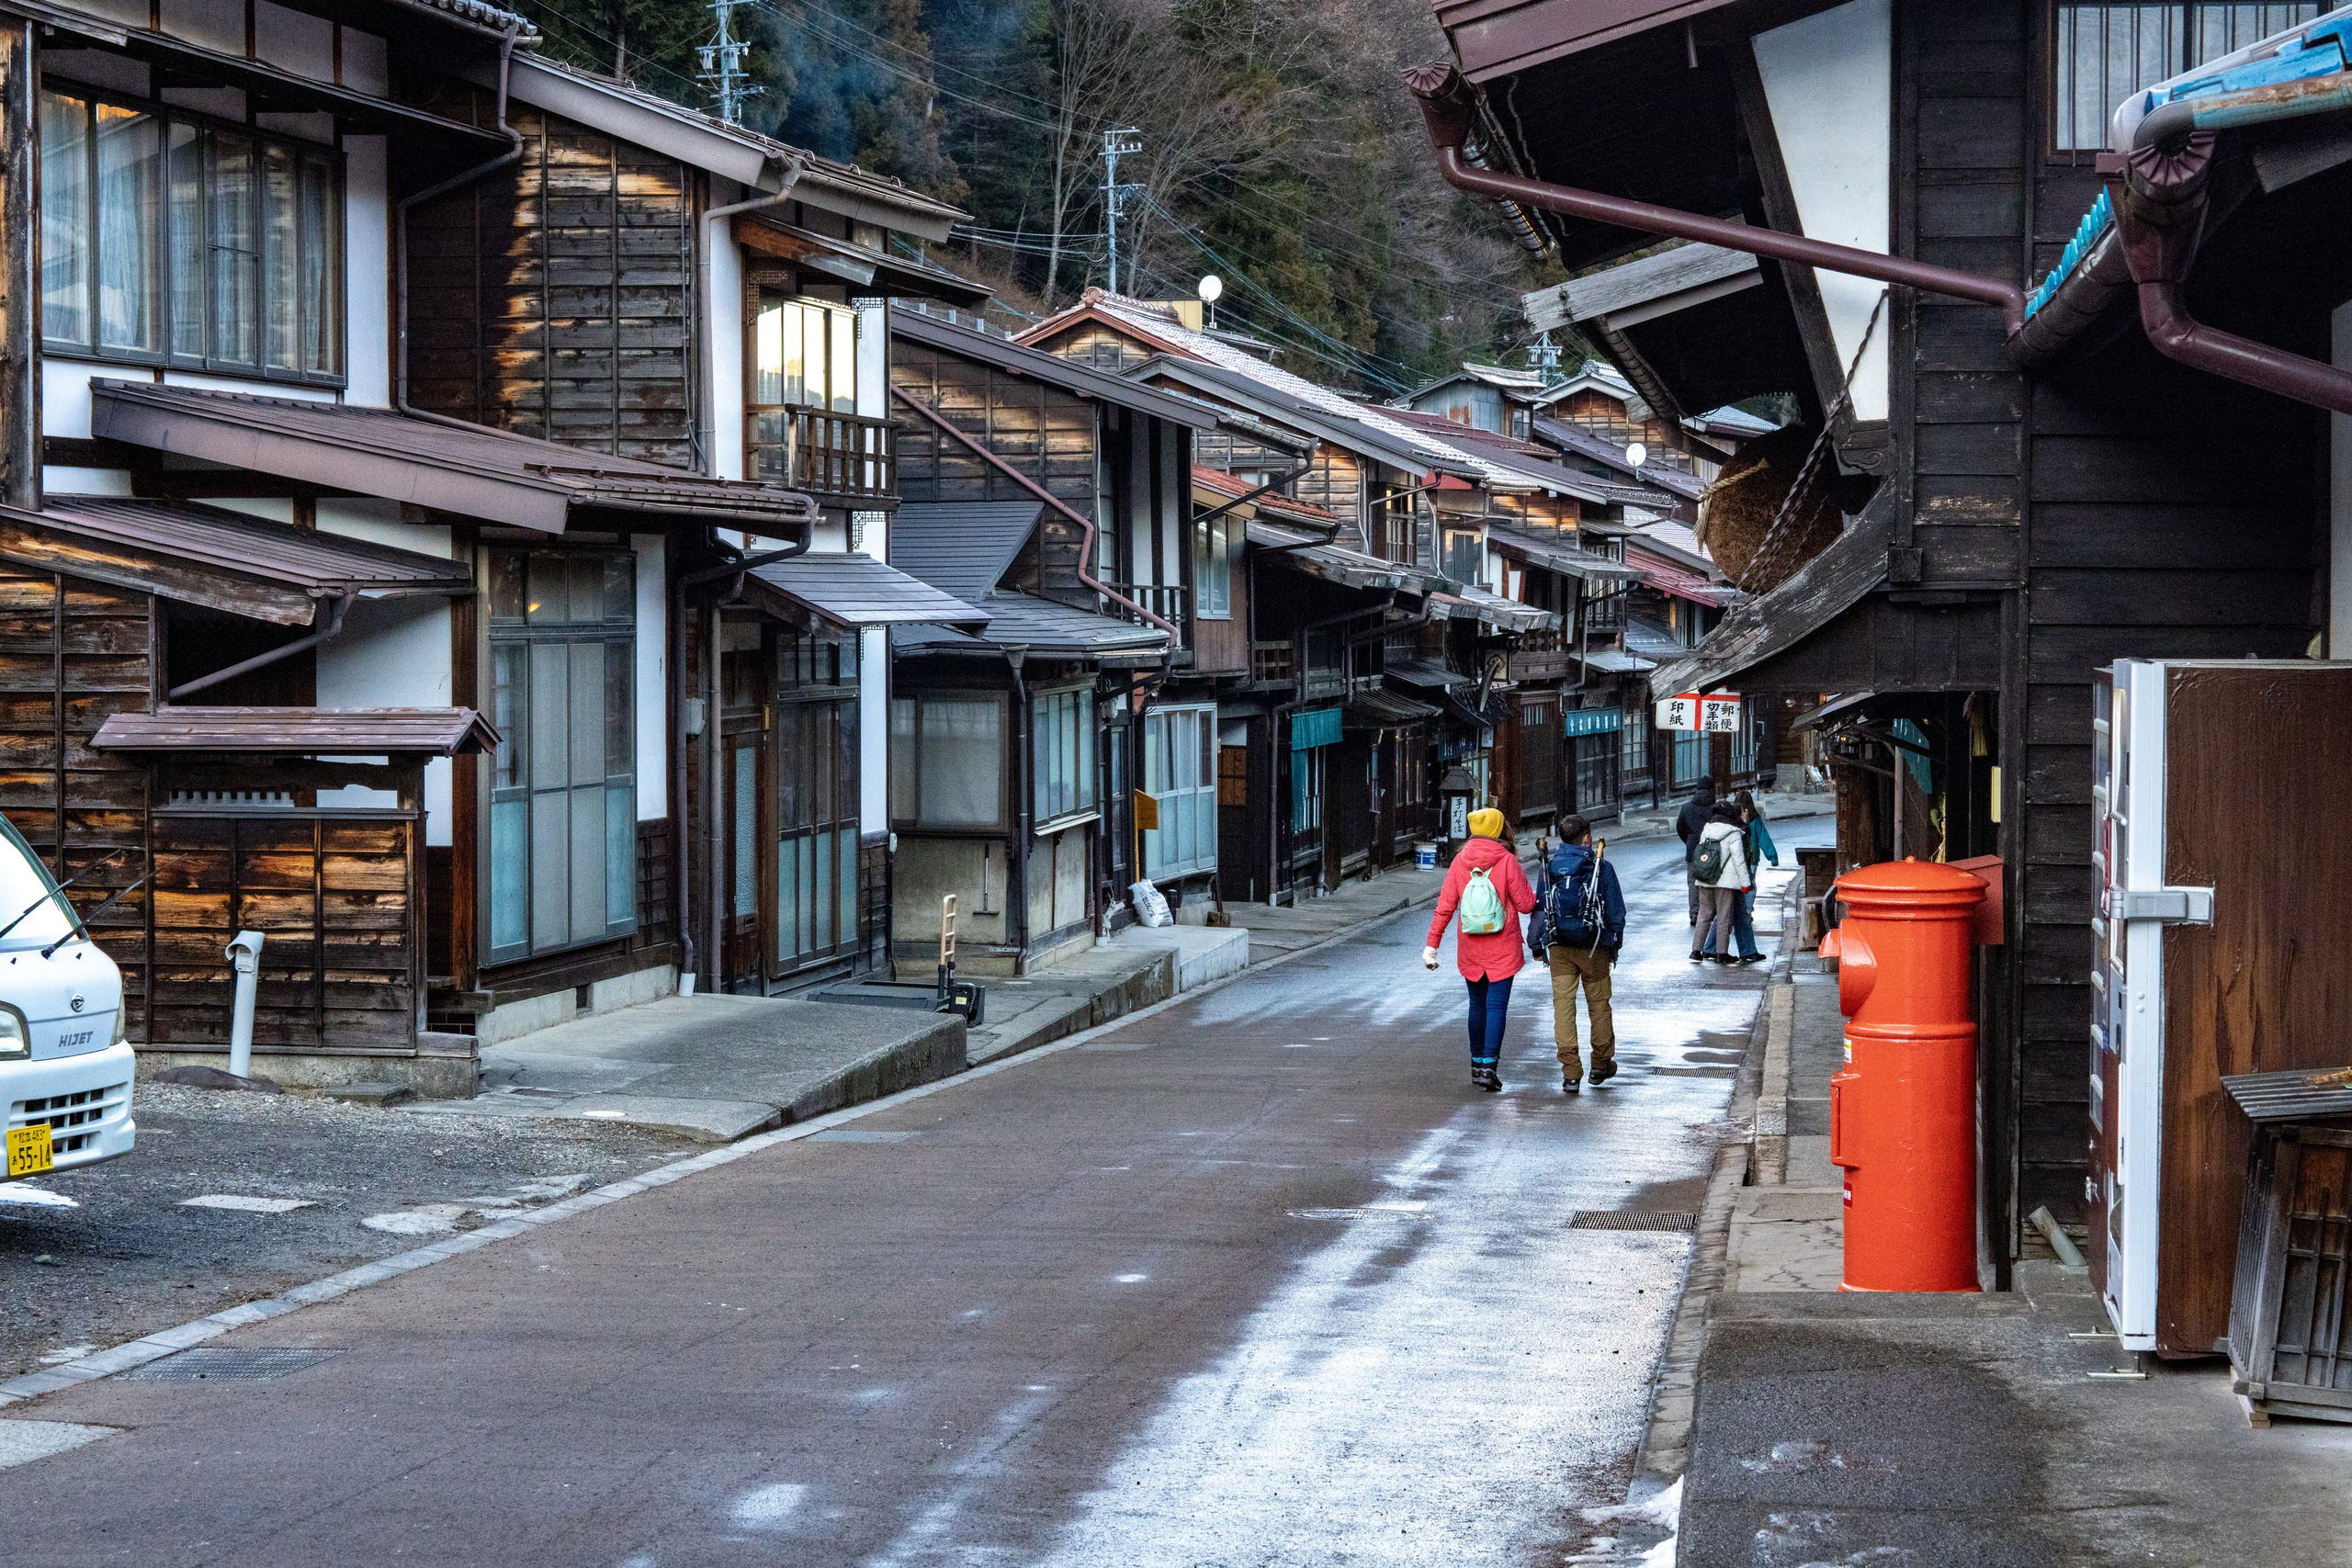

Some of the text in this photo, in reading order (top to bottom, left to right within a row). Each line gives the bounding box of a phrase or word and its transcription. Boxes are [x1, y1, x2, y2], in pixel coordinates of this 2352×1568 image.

[1669, 701, 1684, 726] 印紙
[1705, 703, 1720, 730] 切手類
[1721, 703, 1734, 730] 郵便
[1453, 797, 1464, 833] 手打そば
[58, 1031, 94, 1047] HIJET
